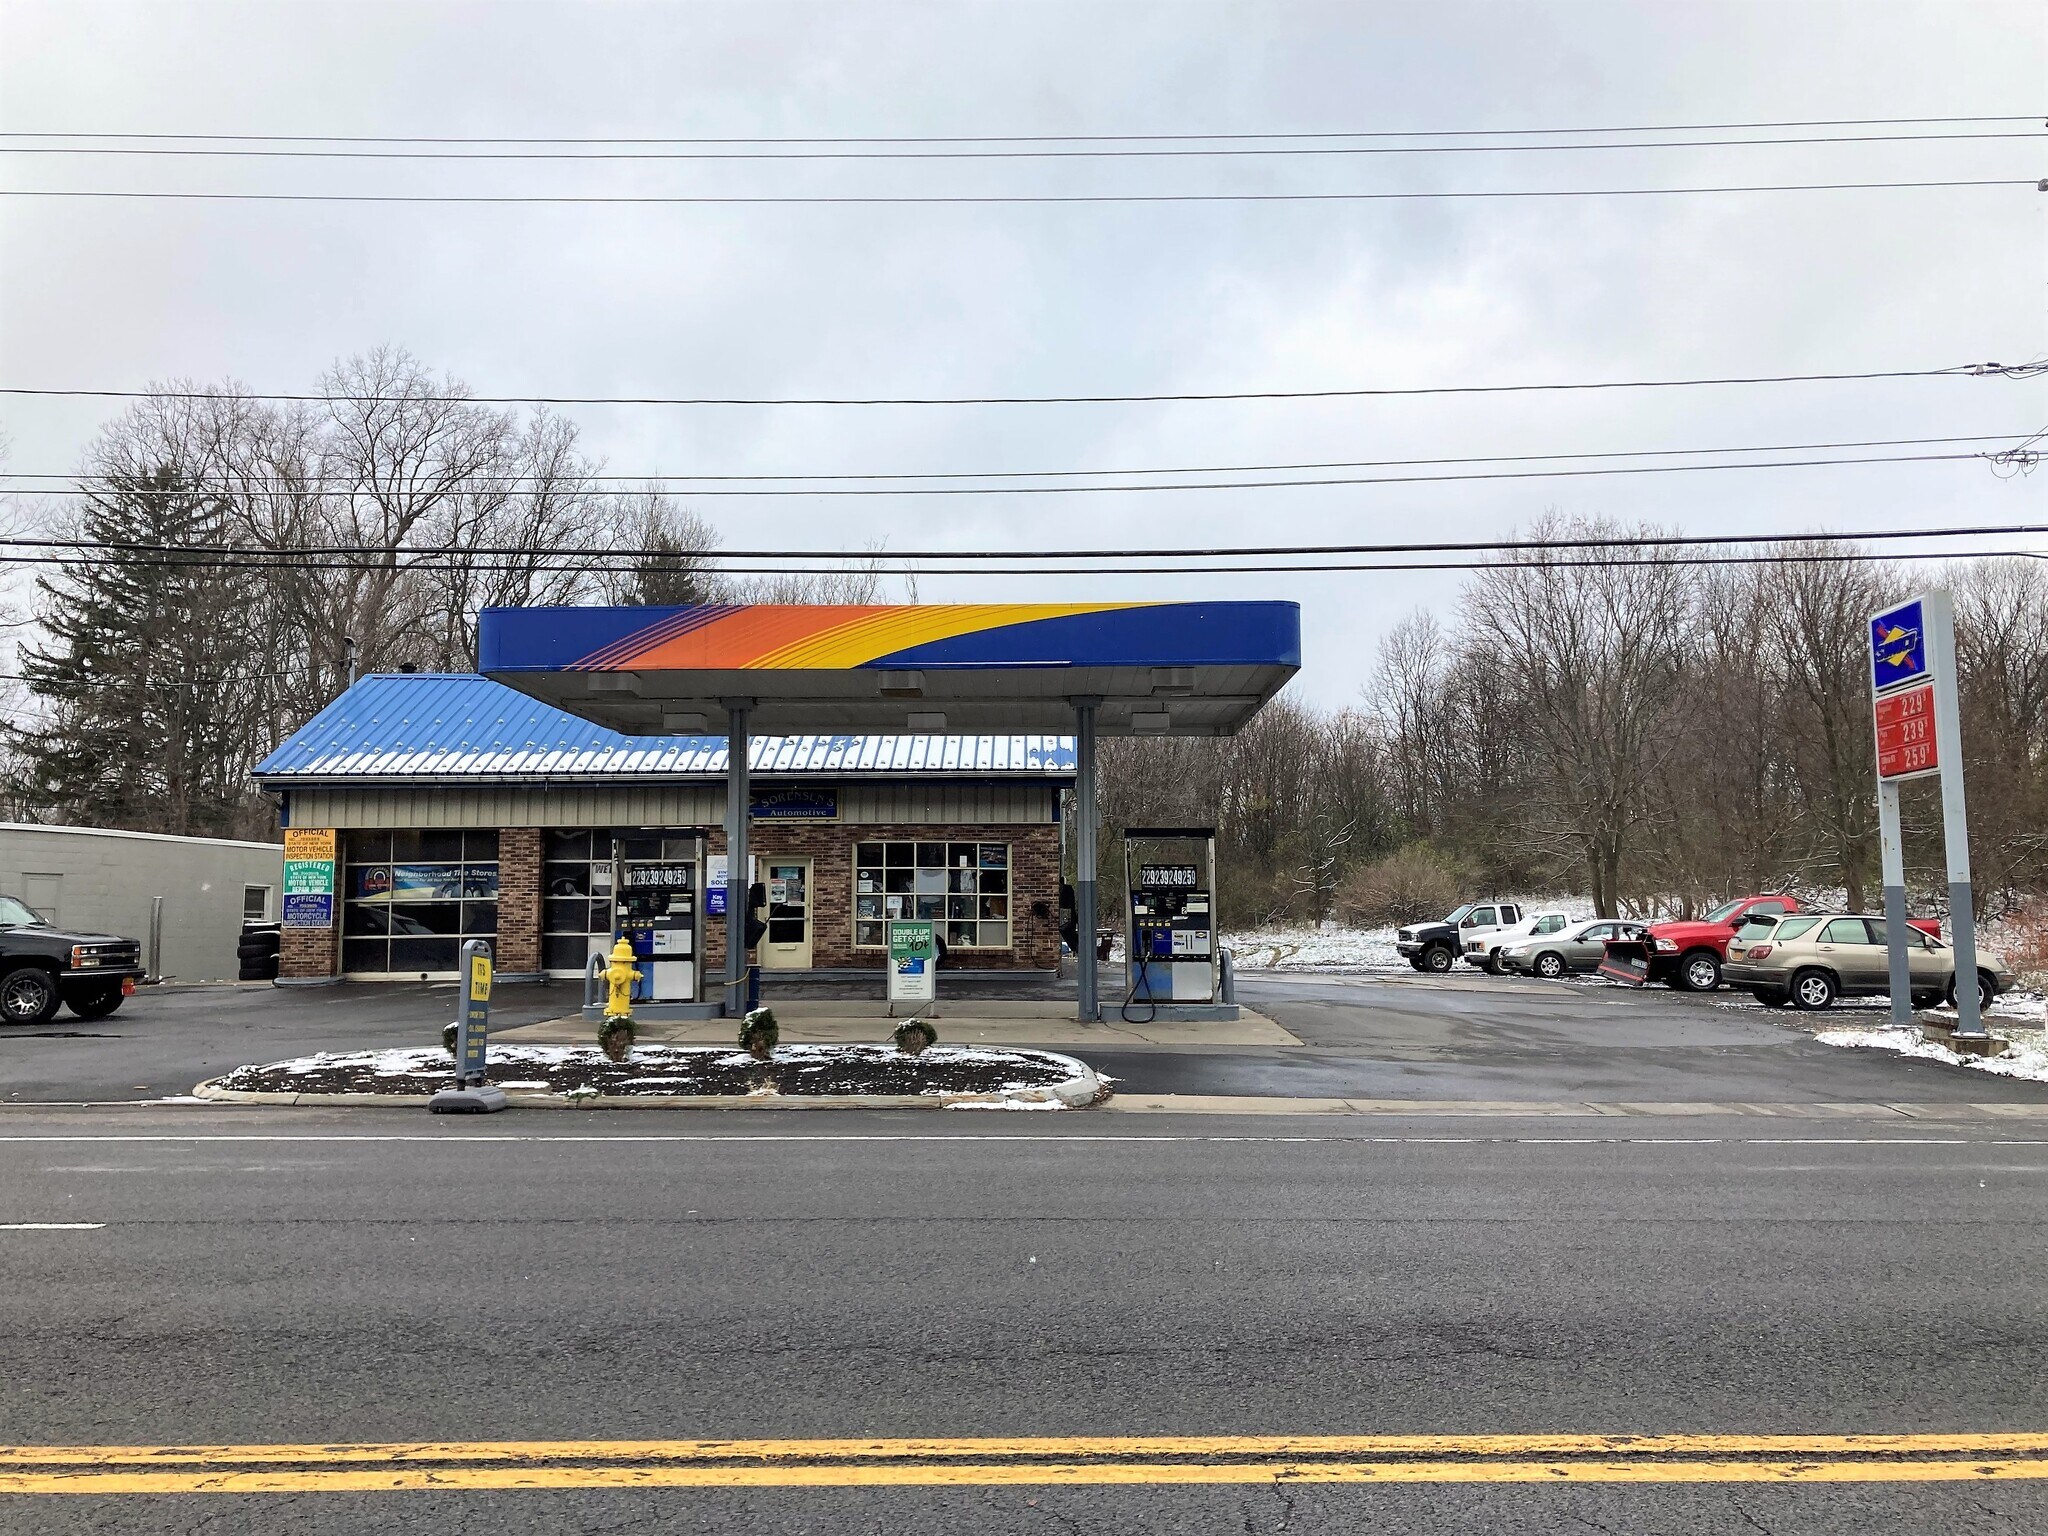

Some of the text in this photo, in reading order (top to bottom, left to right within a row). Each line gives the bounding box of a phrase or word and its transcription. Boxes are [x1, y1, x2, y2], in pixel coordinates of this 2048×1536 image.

[292, 829, 329, 838] OFFICIAL
[290, 861, 331, 872] REGISTERED
[394, 870, 452, 878] Neighborhood
[453, 869, 469, 877] Tie
[471, 869, 498, 877] Stores
[290, 896, 327, 905] OFFICIAL
[286, 912, 328, 920] MOTORCYCLE
[475, 981, 488, 995] TIME
